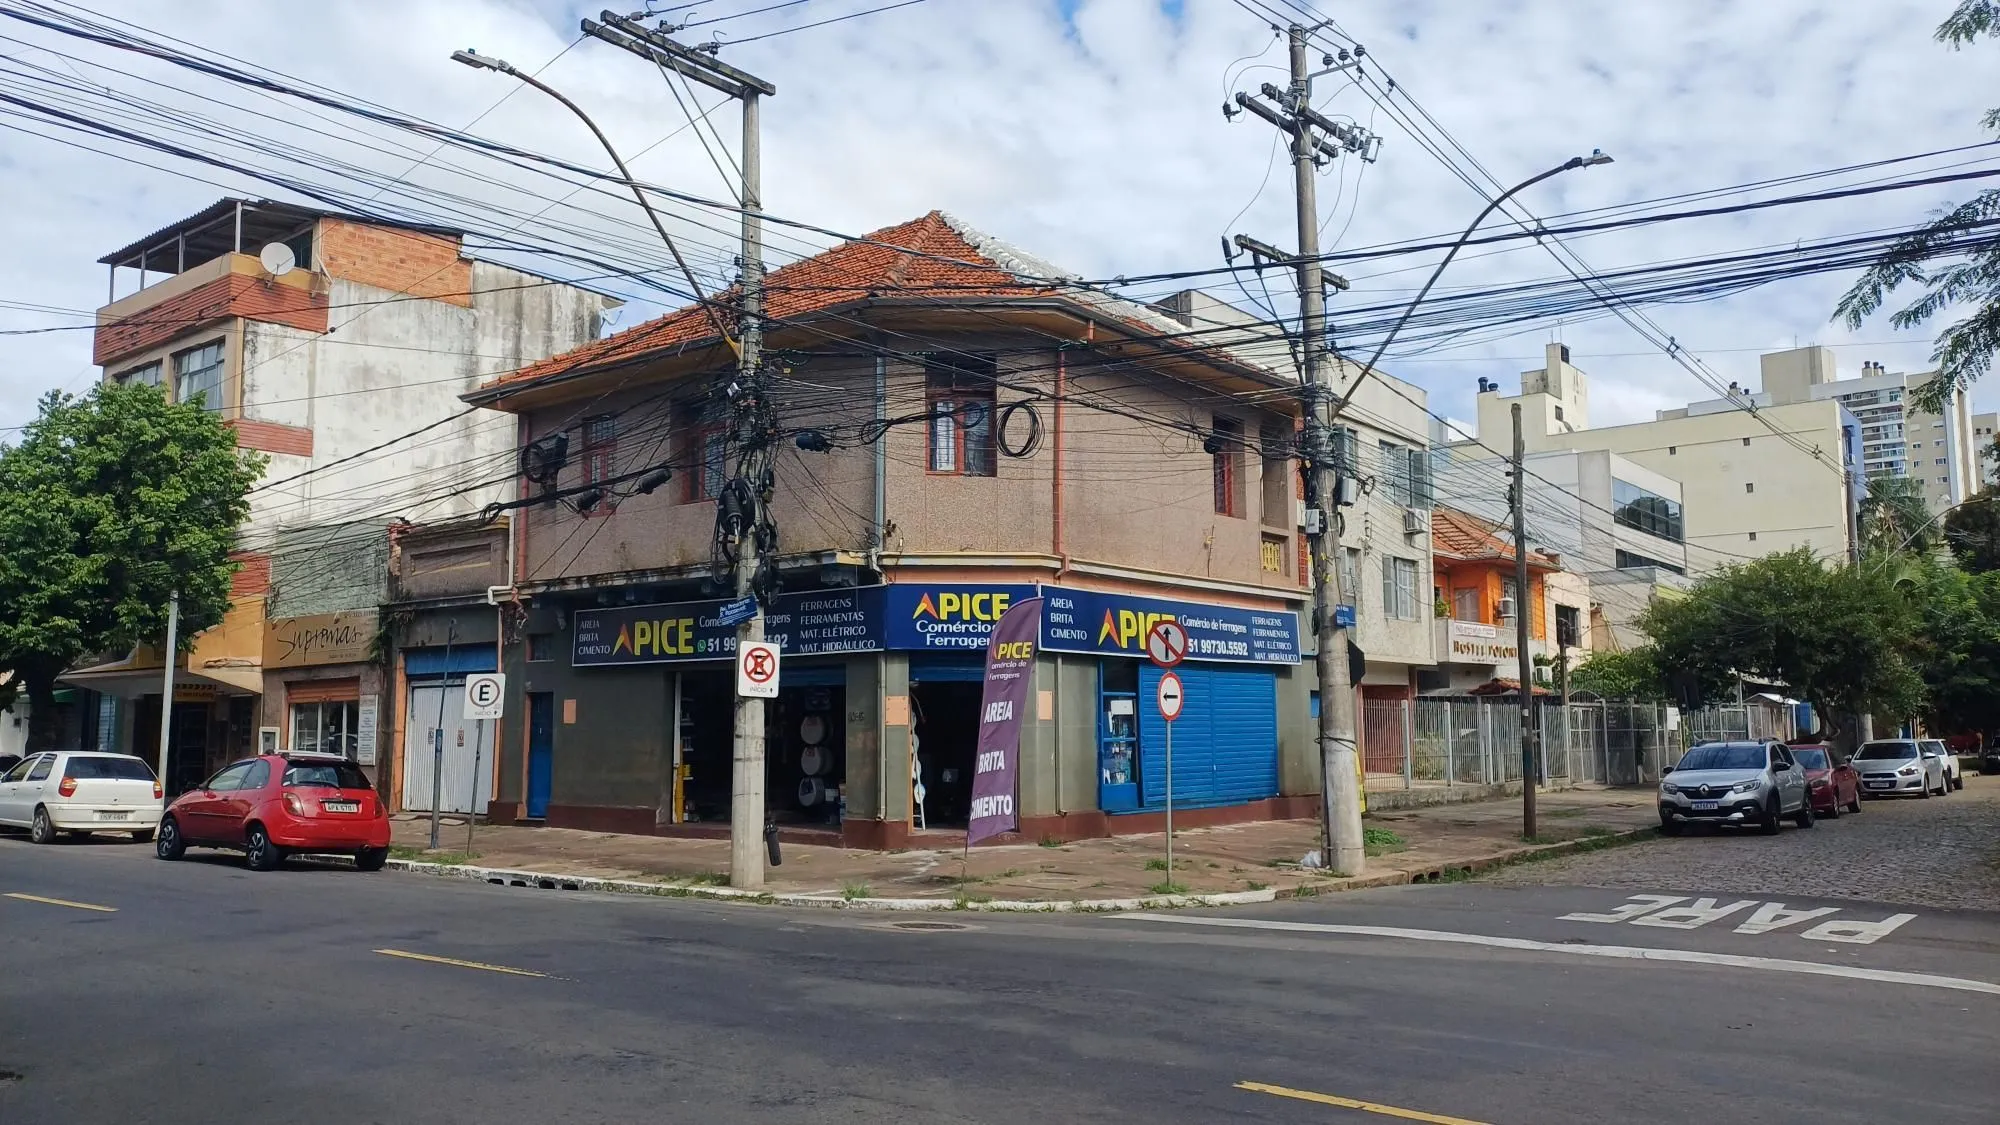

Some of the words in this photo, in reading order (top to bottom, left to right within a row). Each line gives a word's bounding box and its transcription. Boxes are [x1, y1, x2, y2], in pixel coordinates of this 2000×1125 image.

[800, 598, 852, 611] FERRAGENS
[912, 592, 1010, 620] APICE
[1050, 598, 1073, 610] AREIA
[580, 619, 600, 630] AREIA
[800, 611, 864, 625] FERRAMENTAS
[1050, 613, 1073, 625] BRITA
[1182, 614, 1211, 629] Comércio
[1211, 620, 1219, 630] de
[1219, 620, 1247, 635] Ferragens
[1251, 616, 1282, 627] FERRAGENS
[800, 628, 821, 639] MAT.
[822, 625, 866, 638] ELÉTRICO
[915, 620, 993, 633] Comércio
[1098, 607, 1175, 650] APIC
[578, 632, 599, 643] BRITA
[612, 618, 694, 656] APICE
[1050, 628, 1088, 640] CIMENTO
[1252, 629, 1290, 639] FERRAMENTAS
[578, 645, 611, 655] CIMENTO
[707, 637, 720, 652] 51
[800, 642, 821, 653] MAT.
[822, 639, 876, 652] HIDRÁULICO
[1188, 638, 1198, 653] 51
[1200, 638, 1249, 656] 99730.5592
[1267, 640, 1292, 650] ELÉTRICO
[1267, 652, 1298, 662] HIDRÁULICO
[991, 661, 1017, 670] omércio
[1018, 660, 1027, 668] de
[479, 684, 491, 702] E
[983, 700, 1013, 724] AREIA
[977, 750, 1005, 774] BRITA
[1554, 893, 1918, 945] PARE
